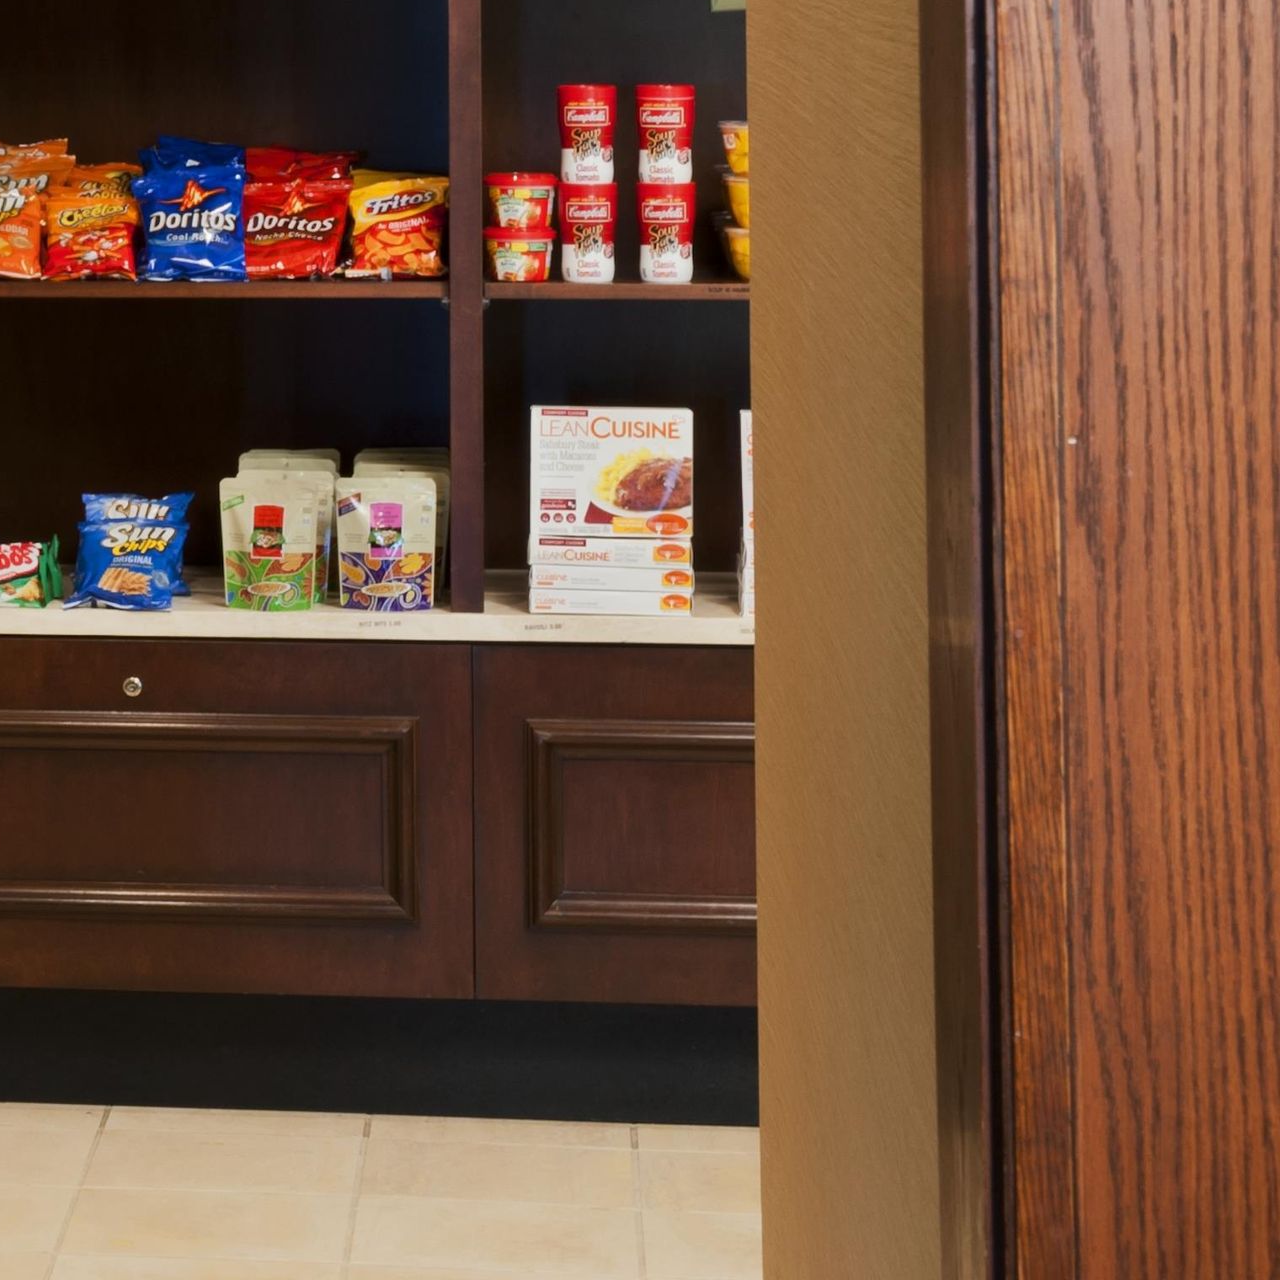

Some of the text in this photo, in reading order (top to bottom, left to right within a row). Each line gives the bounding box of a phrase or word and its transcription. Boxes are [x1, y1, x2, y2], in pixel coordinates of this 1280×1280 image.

[571, 127, 602, 146] Soup
[646, 129, 676, 148] Soup
[363, 188, 433, 216] Fritos
[149, 208, 237, 233] Doritos
[246, 211, 335, 233] Doritos
[166, 231, 223, 243] Cool Rach
[572, 224, 603, 242] Soup
[648, 224, 679, 243] Soup
[101, 524, 176, 549] Sun
[112, 539, 167, 556] Chips
[113, 556, 153, 566] ORIGINAL
